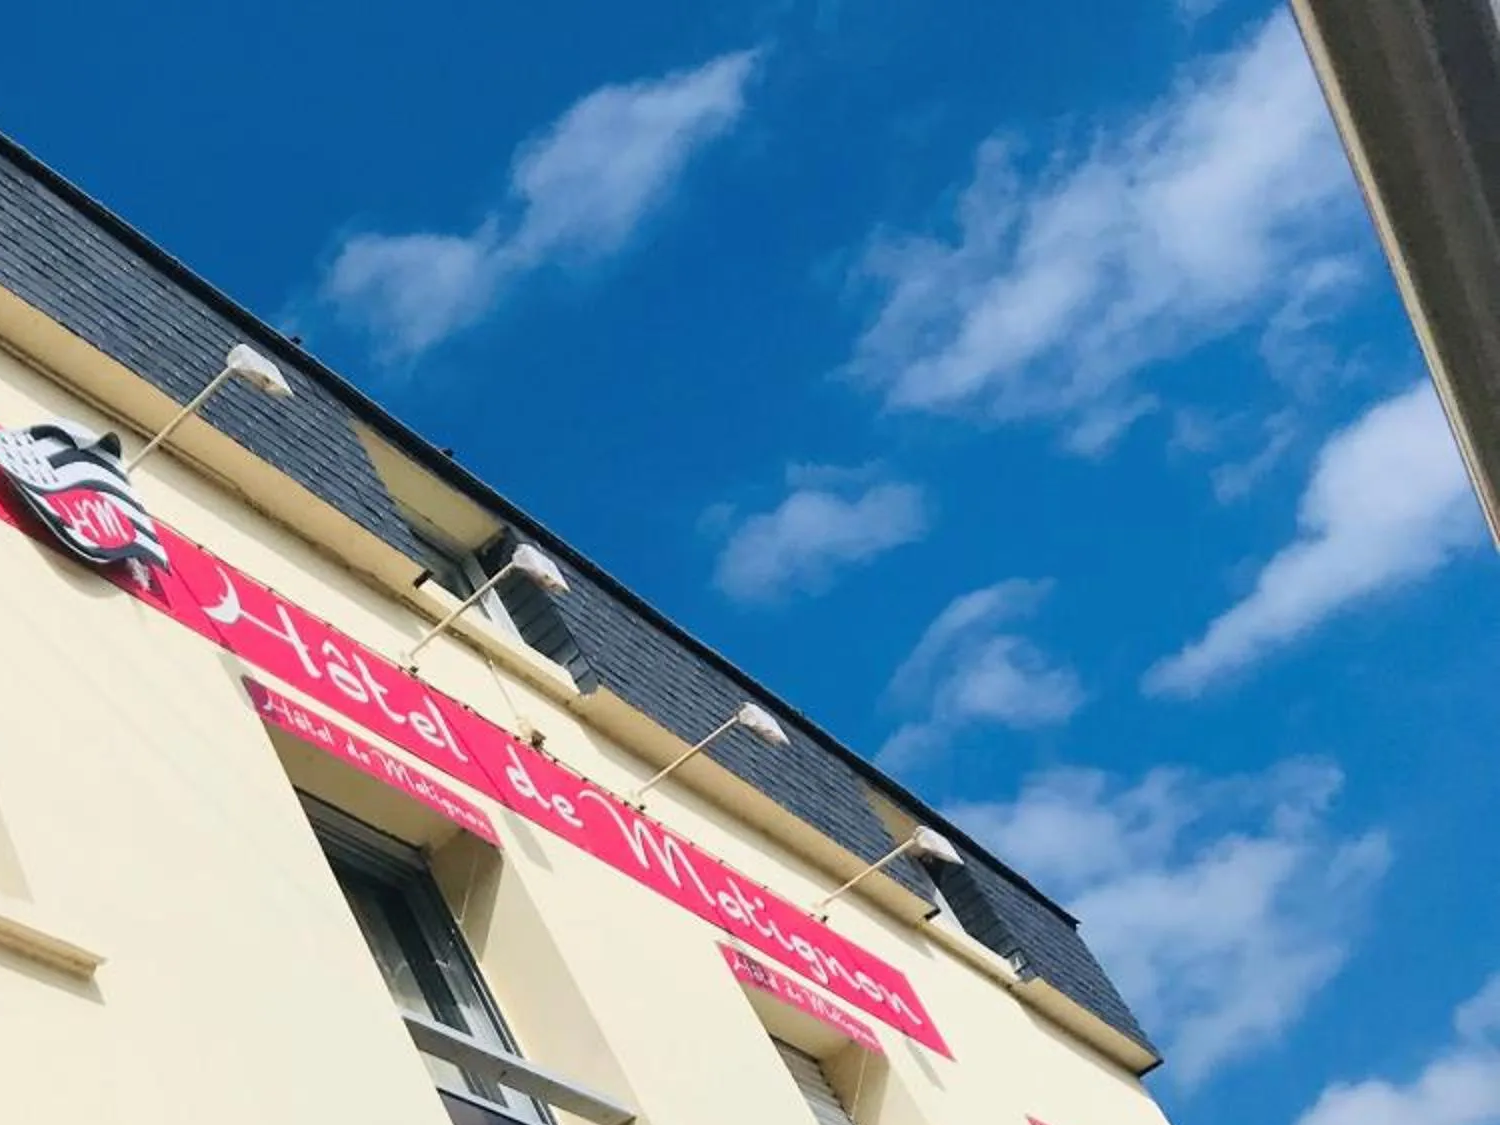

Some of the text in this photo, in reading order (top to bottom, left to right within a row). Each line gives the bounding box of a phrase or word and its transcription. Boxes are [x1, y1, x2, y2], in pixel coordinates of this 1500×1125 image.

[201, 564, 923, 1026] Hôtel de Matignon
[262, 689, 335, 746] Hôtel
